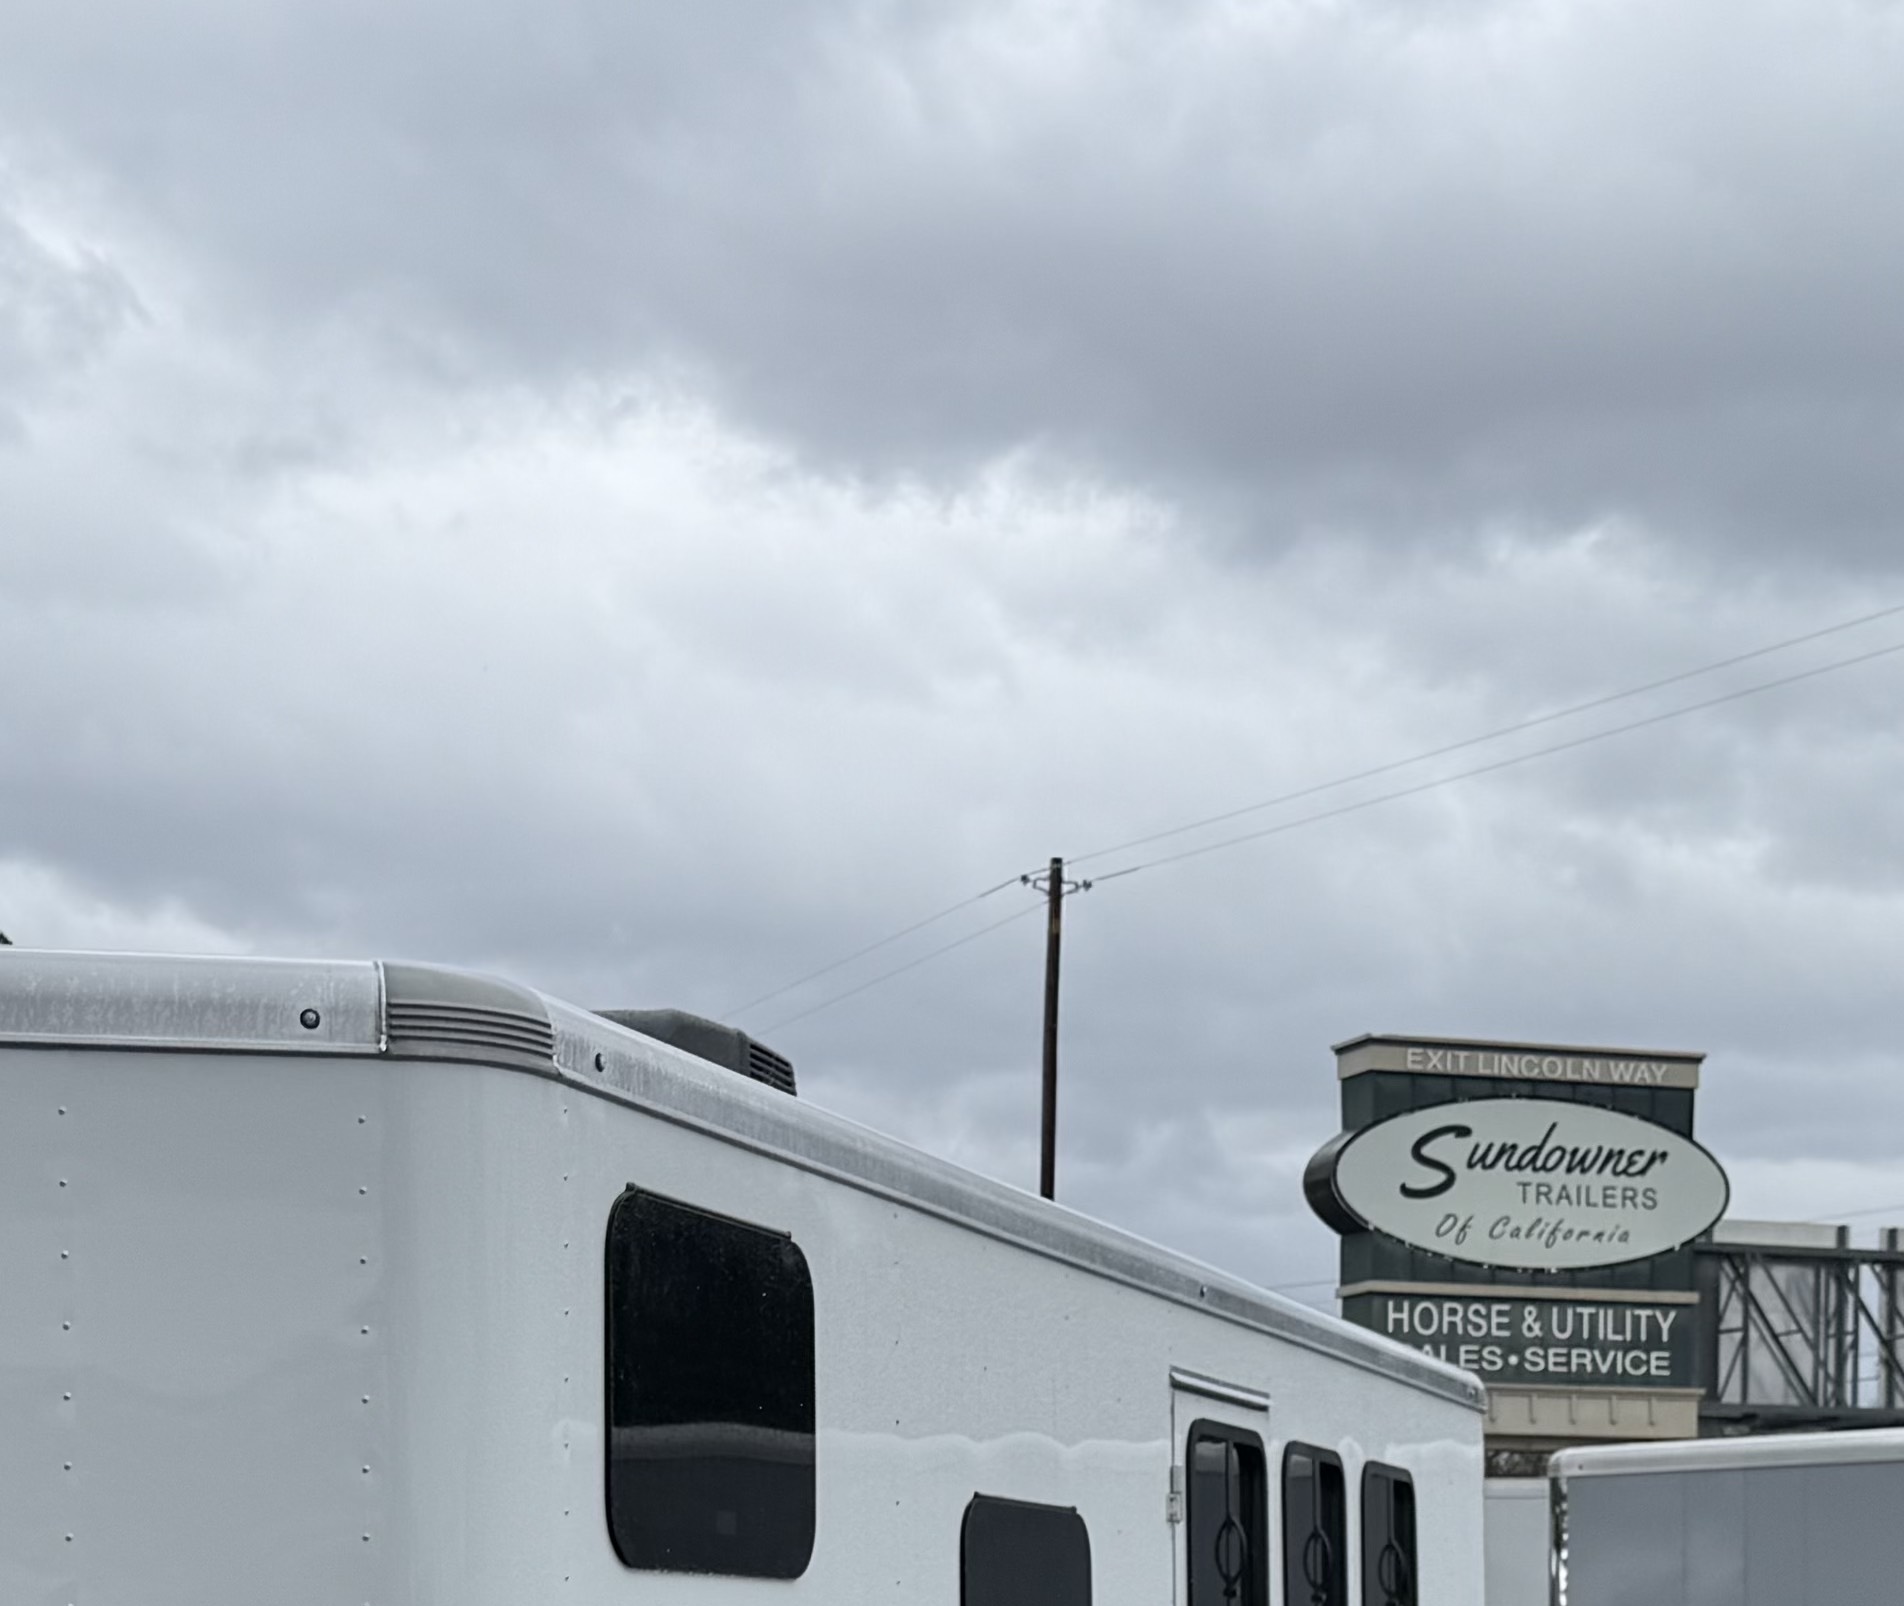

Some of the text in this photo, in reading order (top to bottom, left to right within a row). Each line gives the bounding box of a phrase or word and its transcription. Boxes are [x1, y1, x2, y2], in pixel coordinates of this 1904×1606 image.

[1405, 1047, 1668, 1085] EXIT LINCOLN WAY
[1399, 1122, 1669, 1200] Sundowner
[1517, 1181, 1659, 1211] TRAILERS
[1435, 1213, 1631, 1249] Of California
[1387, 1300, 1677, 1343] HORSE & UTILITY
[1524, 1347, 1672, 1377] SERVICE
